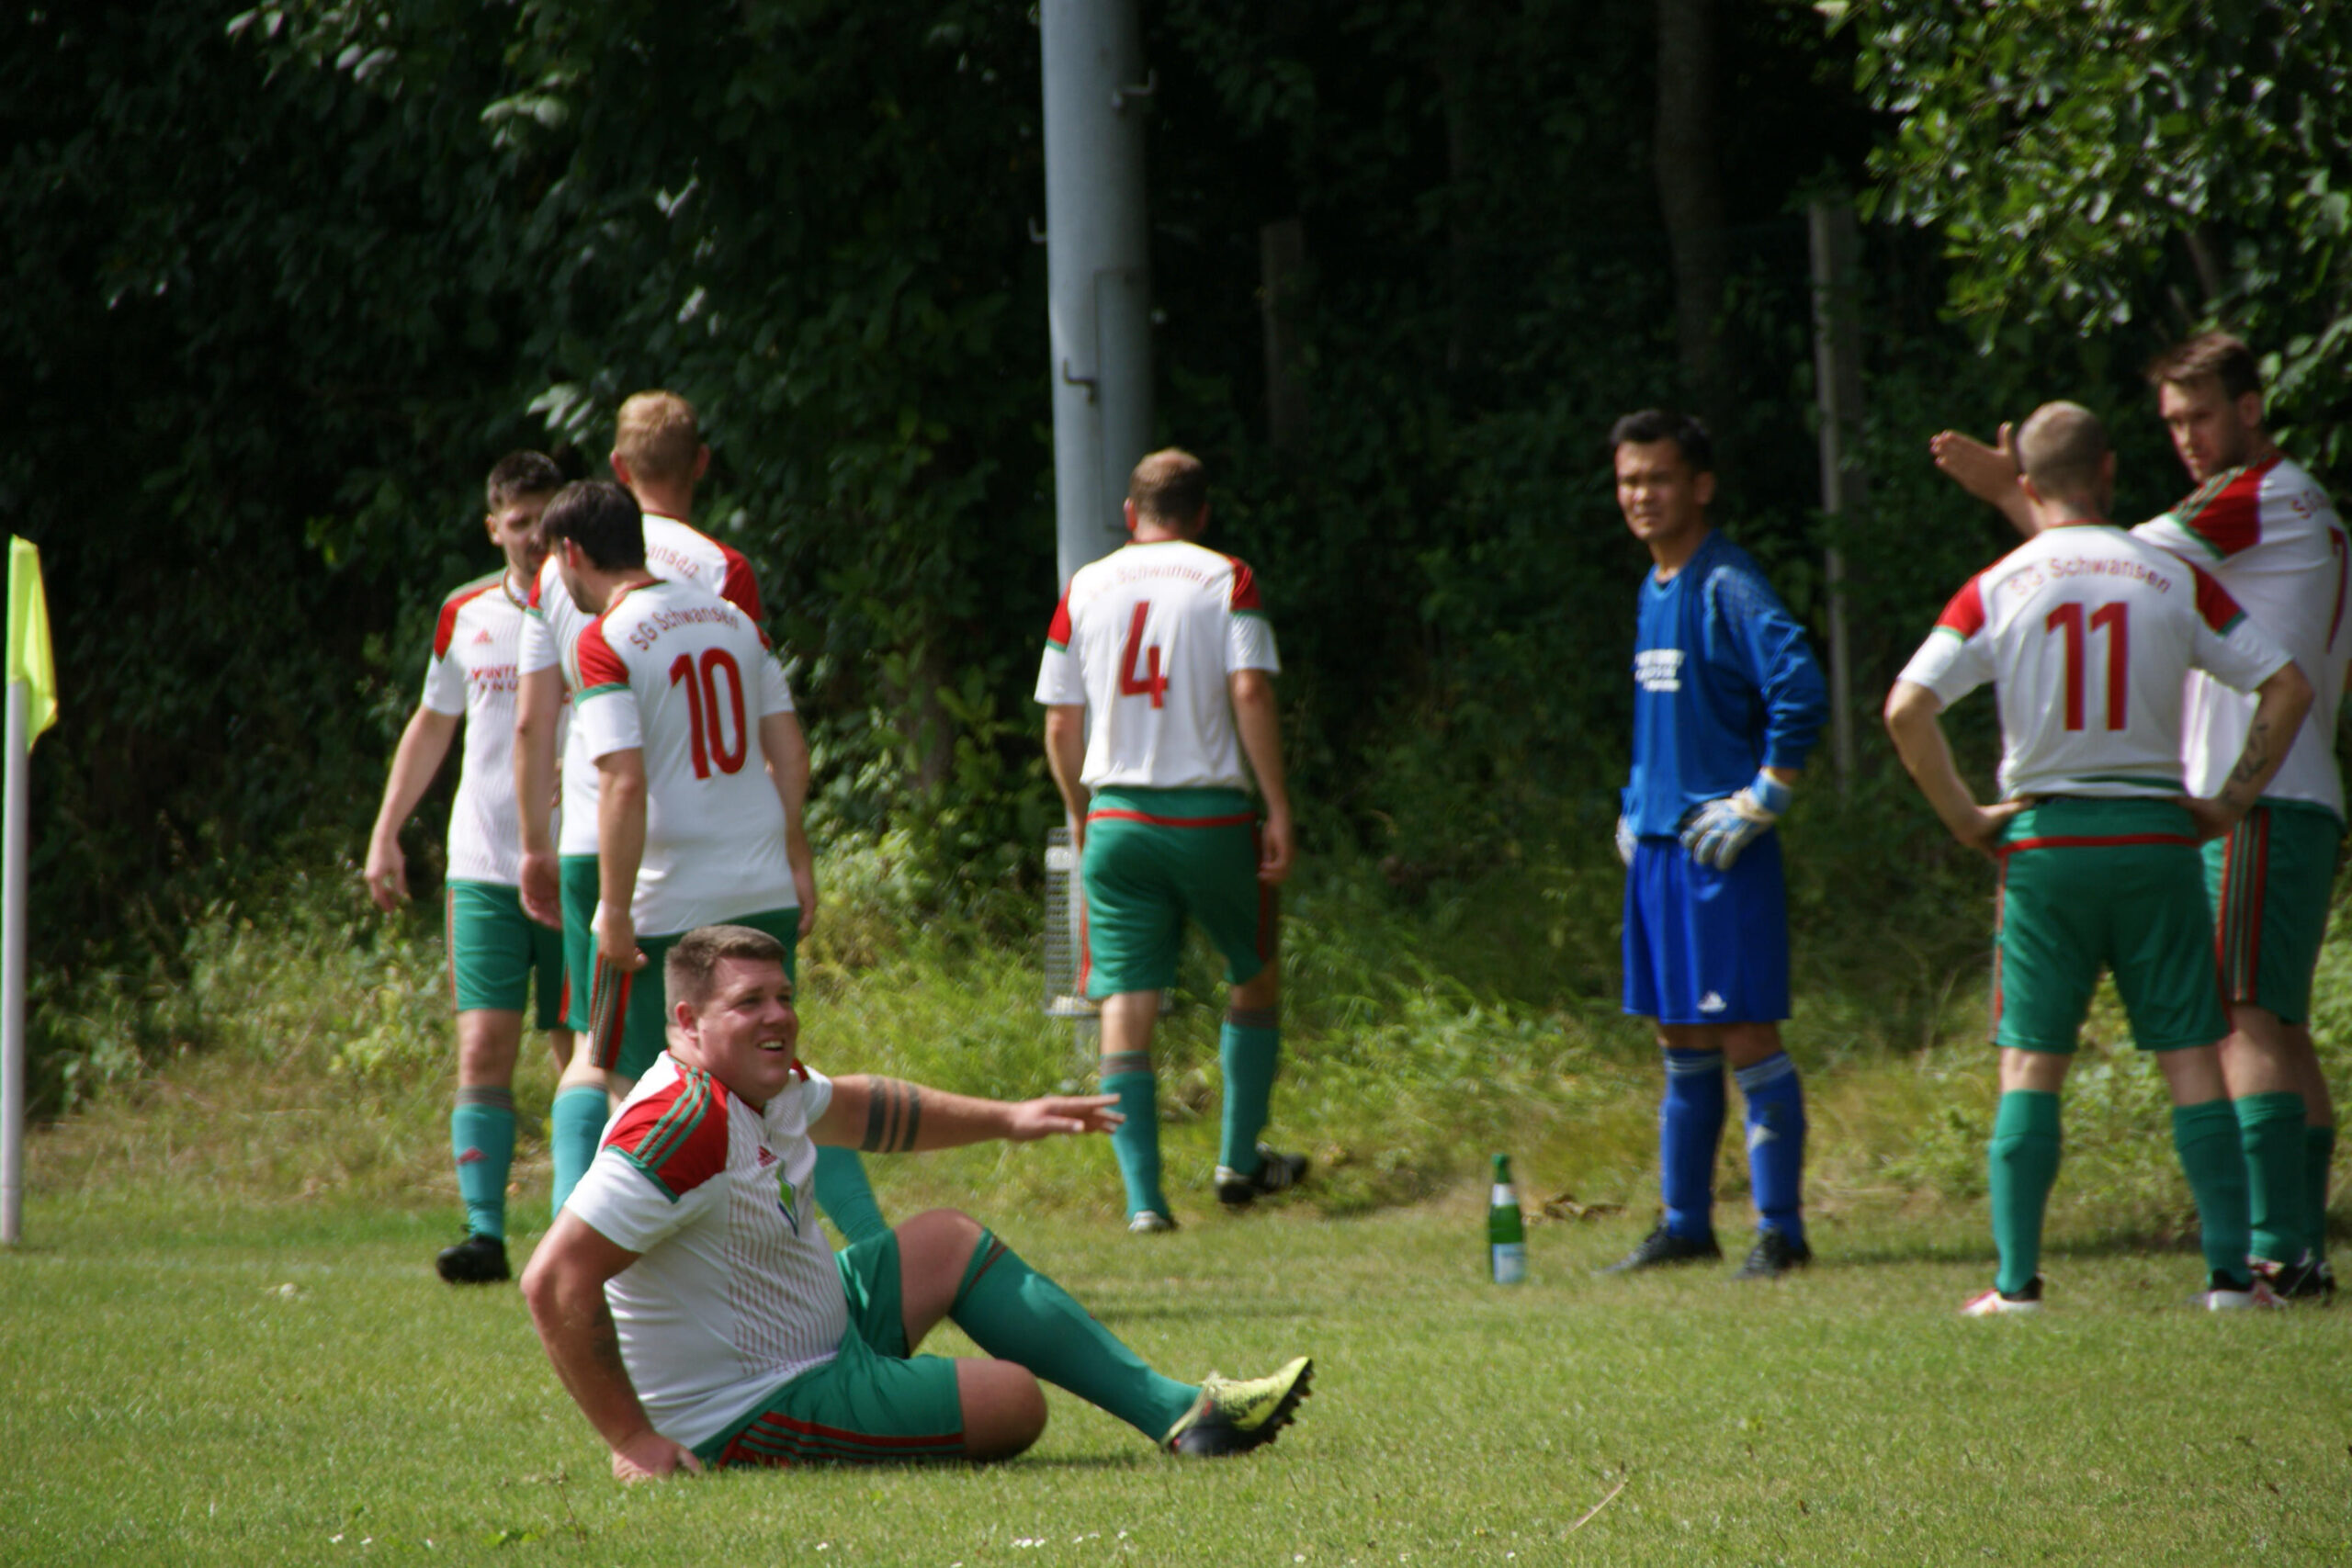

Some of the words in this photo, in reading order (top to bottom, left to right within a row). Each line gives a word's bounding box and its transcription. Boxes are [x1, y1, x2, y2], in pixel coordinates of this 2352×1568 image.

[2049, 556, 2171, 593] Schwansen
[629, 622, 658, 651] SG
[1120, 600, 1169, 709] 4
[2045, 602, 2129, 731] 11
[670, 648, 747, 779] 10
